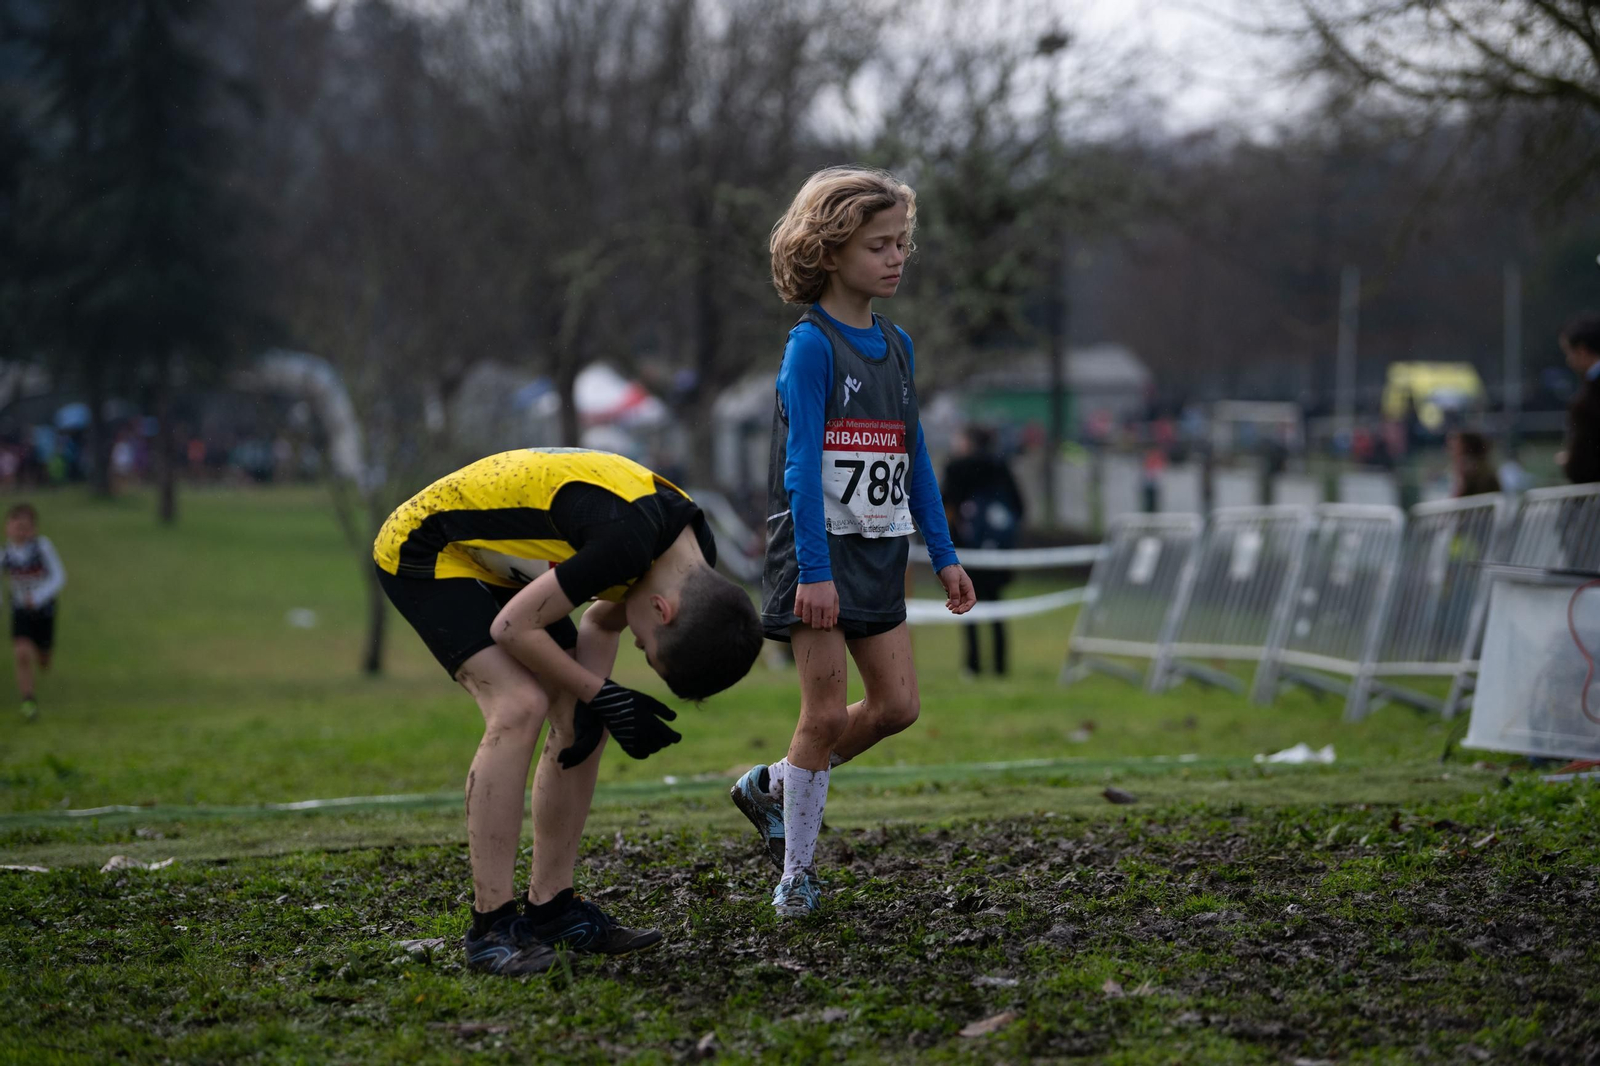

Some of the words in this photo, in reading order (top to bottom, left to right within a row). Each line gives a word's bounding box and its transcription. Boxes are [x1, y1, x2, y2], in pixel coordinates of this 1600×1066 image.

[846, 420, 879, 429] Memorial
[825, 431, 897, 447] RIBADAVIA
[834, 459, 905, 506] 788
